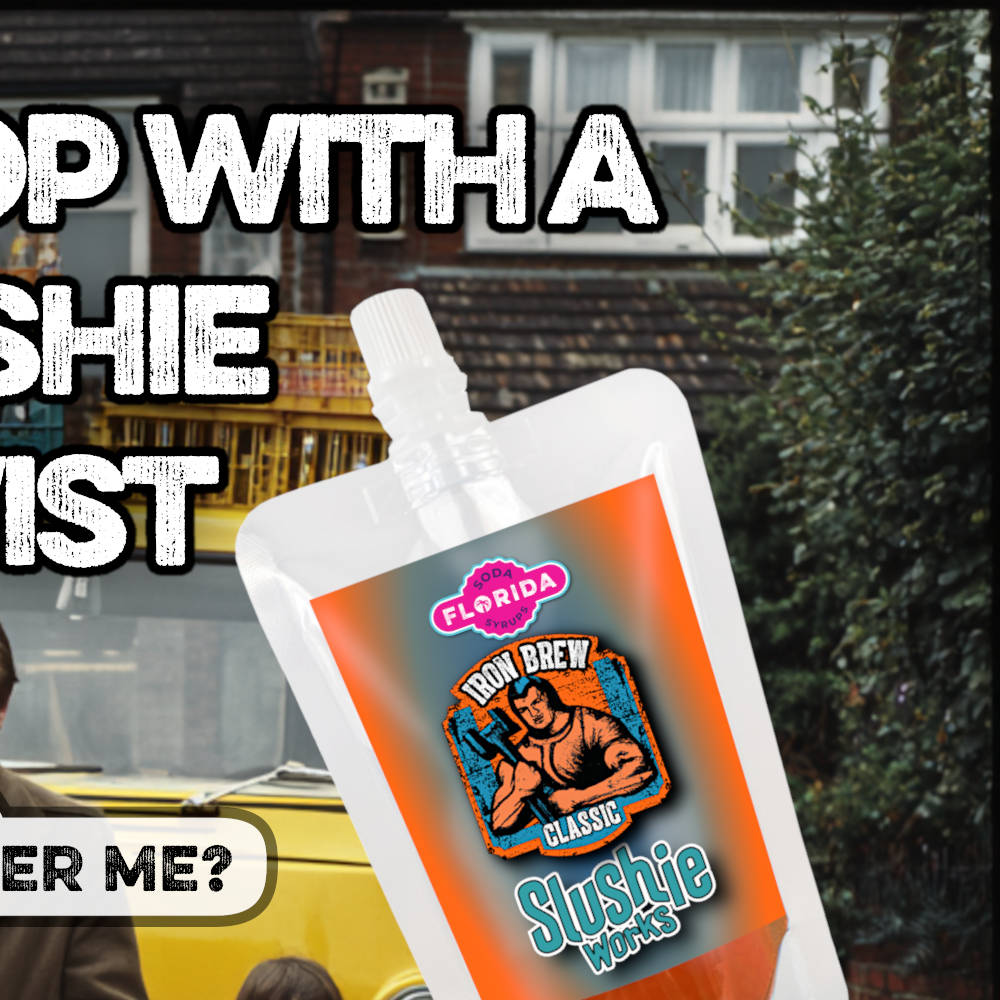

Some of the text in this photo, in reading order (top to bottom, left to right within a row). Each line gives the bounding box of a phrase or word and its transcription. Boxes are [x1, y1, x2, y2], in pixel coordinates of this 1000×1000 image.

[442, 572, 557, 627] FLORIDA
[473, 567, 513, 590] SODA
[485, 606, 529, 630] SYRUPS
[461, 639, 590, 707] IRON BREW
[543, 800, 622, 848] CLASSIC
